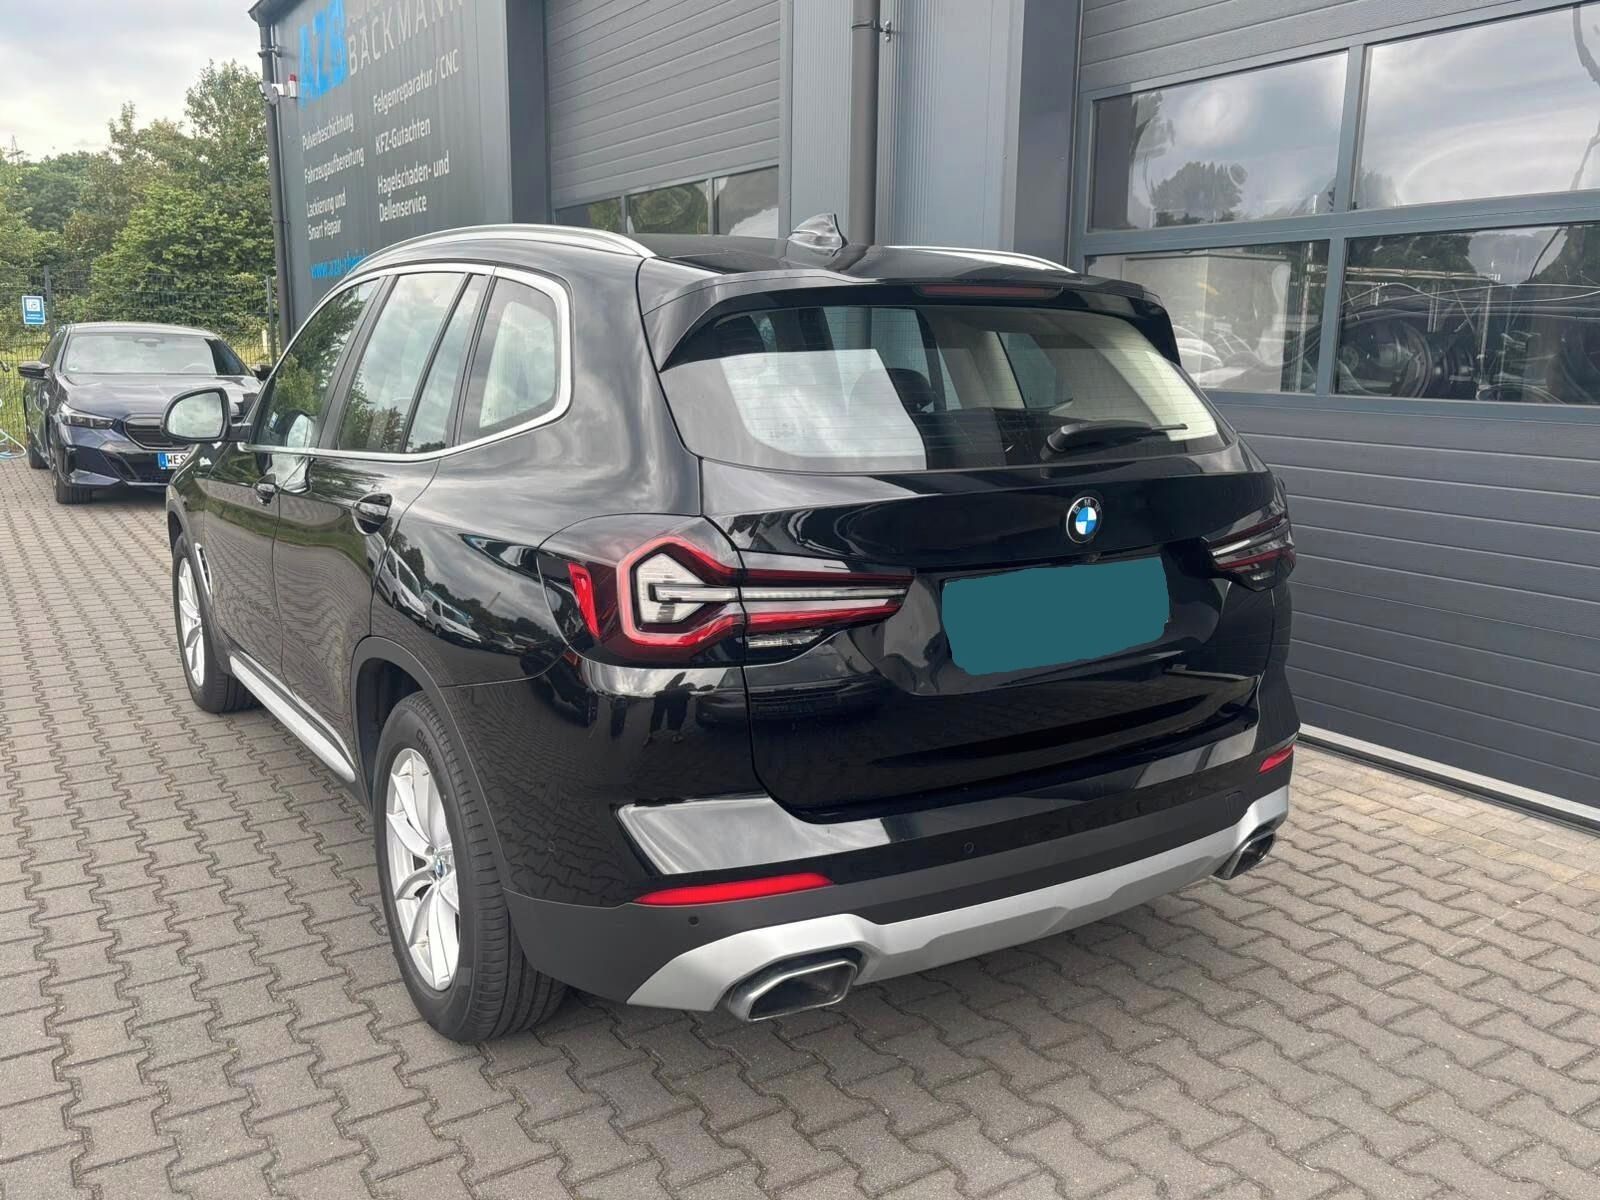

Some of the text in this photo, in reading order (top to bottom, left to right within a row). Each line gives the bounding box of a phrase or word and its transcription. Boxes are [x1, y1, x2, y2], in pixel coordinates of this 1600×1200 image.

[373, 68, 432, 115] Felgenreparatur
[440, 48, 459, 79] CNC
[375, 118, 431, 155] KFZ-Gutachten
[377, 150, 449, 197] Hagelschaden- und
[306, 187, 346, 218] Lackierung und
[379, 191, 427, 222] Dellenservice
[308, 215, 342, 240] Smart Repair
